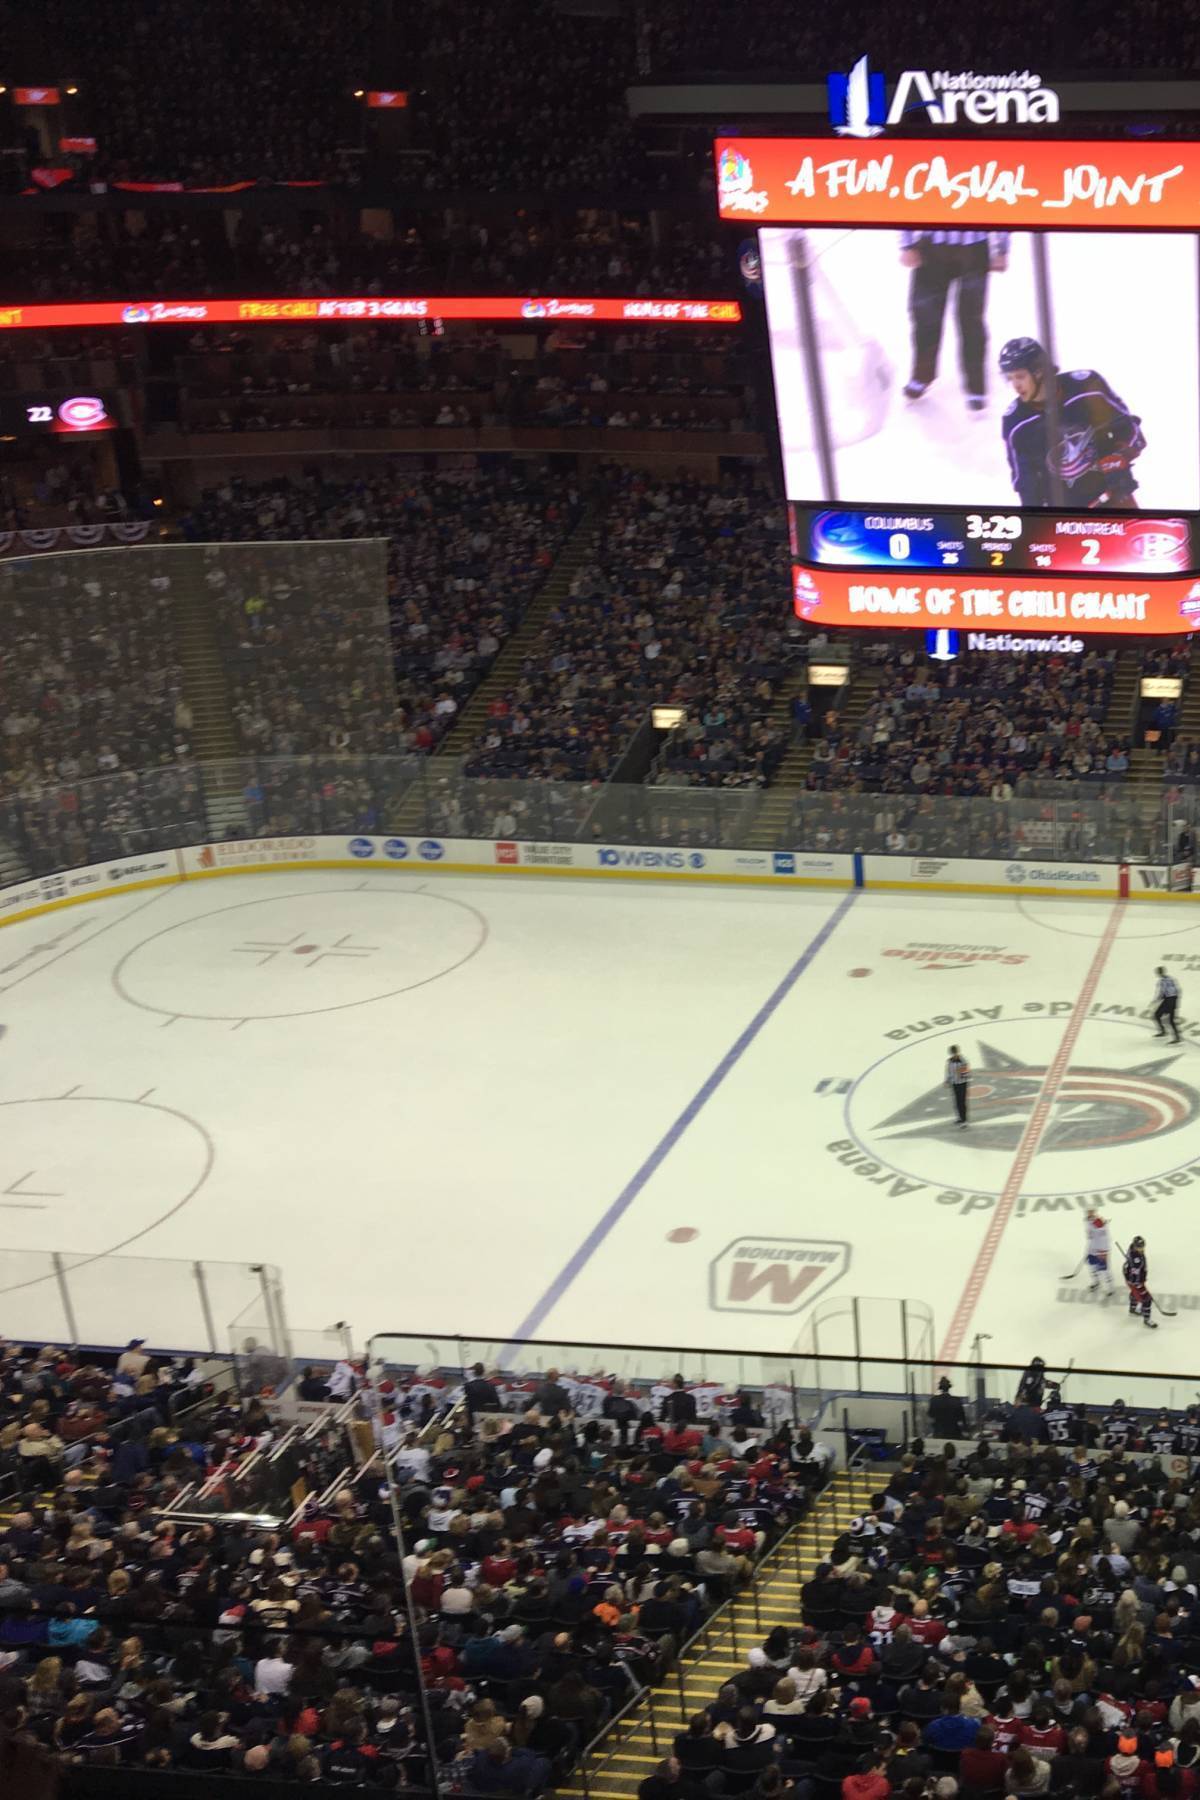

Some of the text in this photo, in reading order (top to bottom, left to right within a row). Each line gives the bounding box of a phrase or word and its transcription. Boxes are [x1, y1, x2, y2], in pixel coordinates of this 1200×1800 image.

[932, 70, 1042, 90] Nationwide
[886, 71, 1060, 124] Arena
[785, 156, 815, 197] A
[903, 157, 1039, 209] CASUAL
[1041, 165, 1183, 208] JOINT
[863, 516, 935, 532] COLUMBUS
[966, 514, 1022, 539] 3:29
[1055, 521, 1128, 536] MONTREAL
[889, 533, 910, 560] 0
[1080, 539, 1101, 566] 2
[990, 553, 1004, 567] 2
[848, 586, 922, 614] HOME
[924, 587, 957, 614] OF
[960, 589, 1004, 616] THE
[1070, 592, 1151, 620] CHANT
[966, 633, 1085, 655] Nationwide
[623, 851, 686, 868] WBNS
[1028, 869, 1100, 882] OhioHealth
[880, 948, 1031, 966] Safelite
[883, 1001, 1004, 1041] Arena
[825, 1137, 928, 1199] Arena
[732, 1246, 841, 1263] MARATHON
